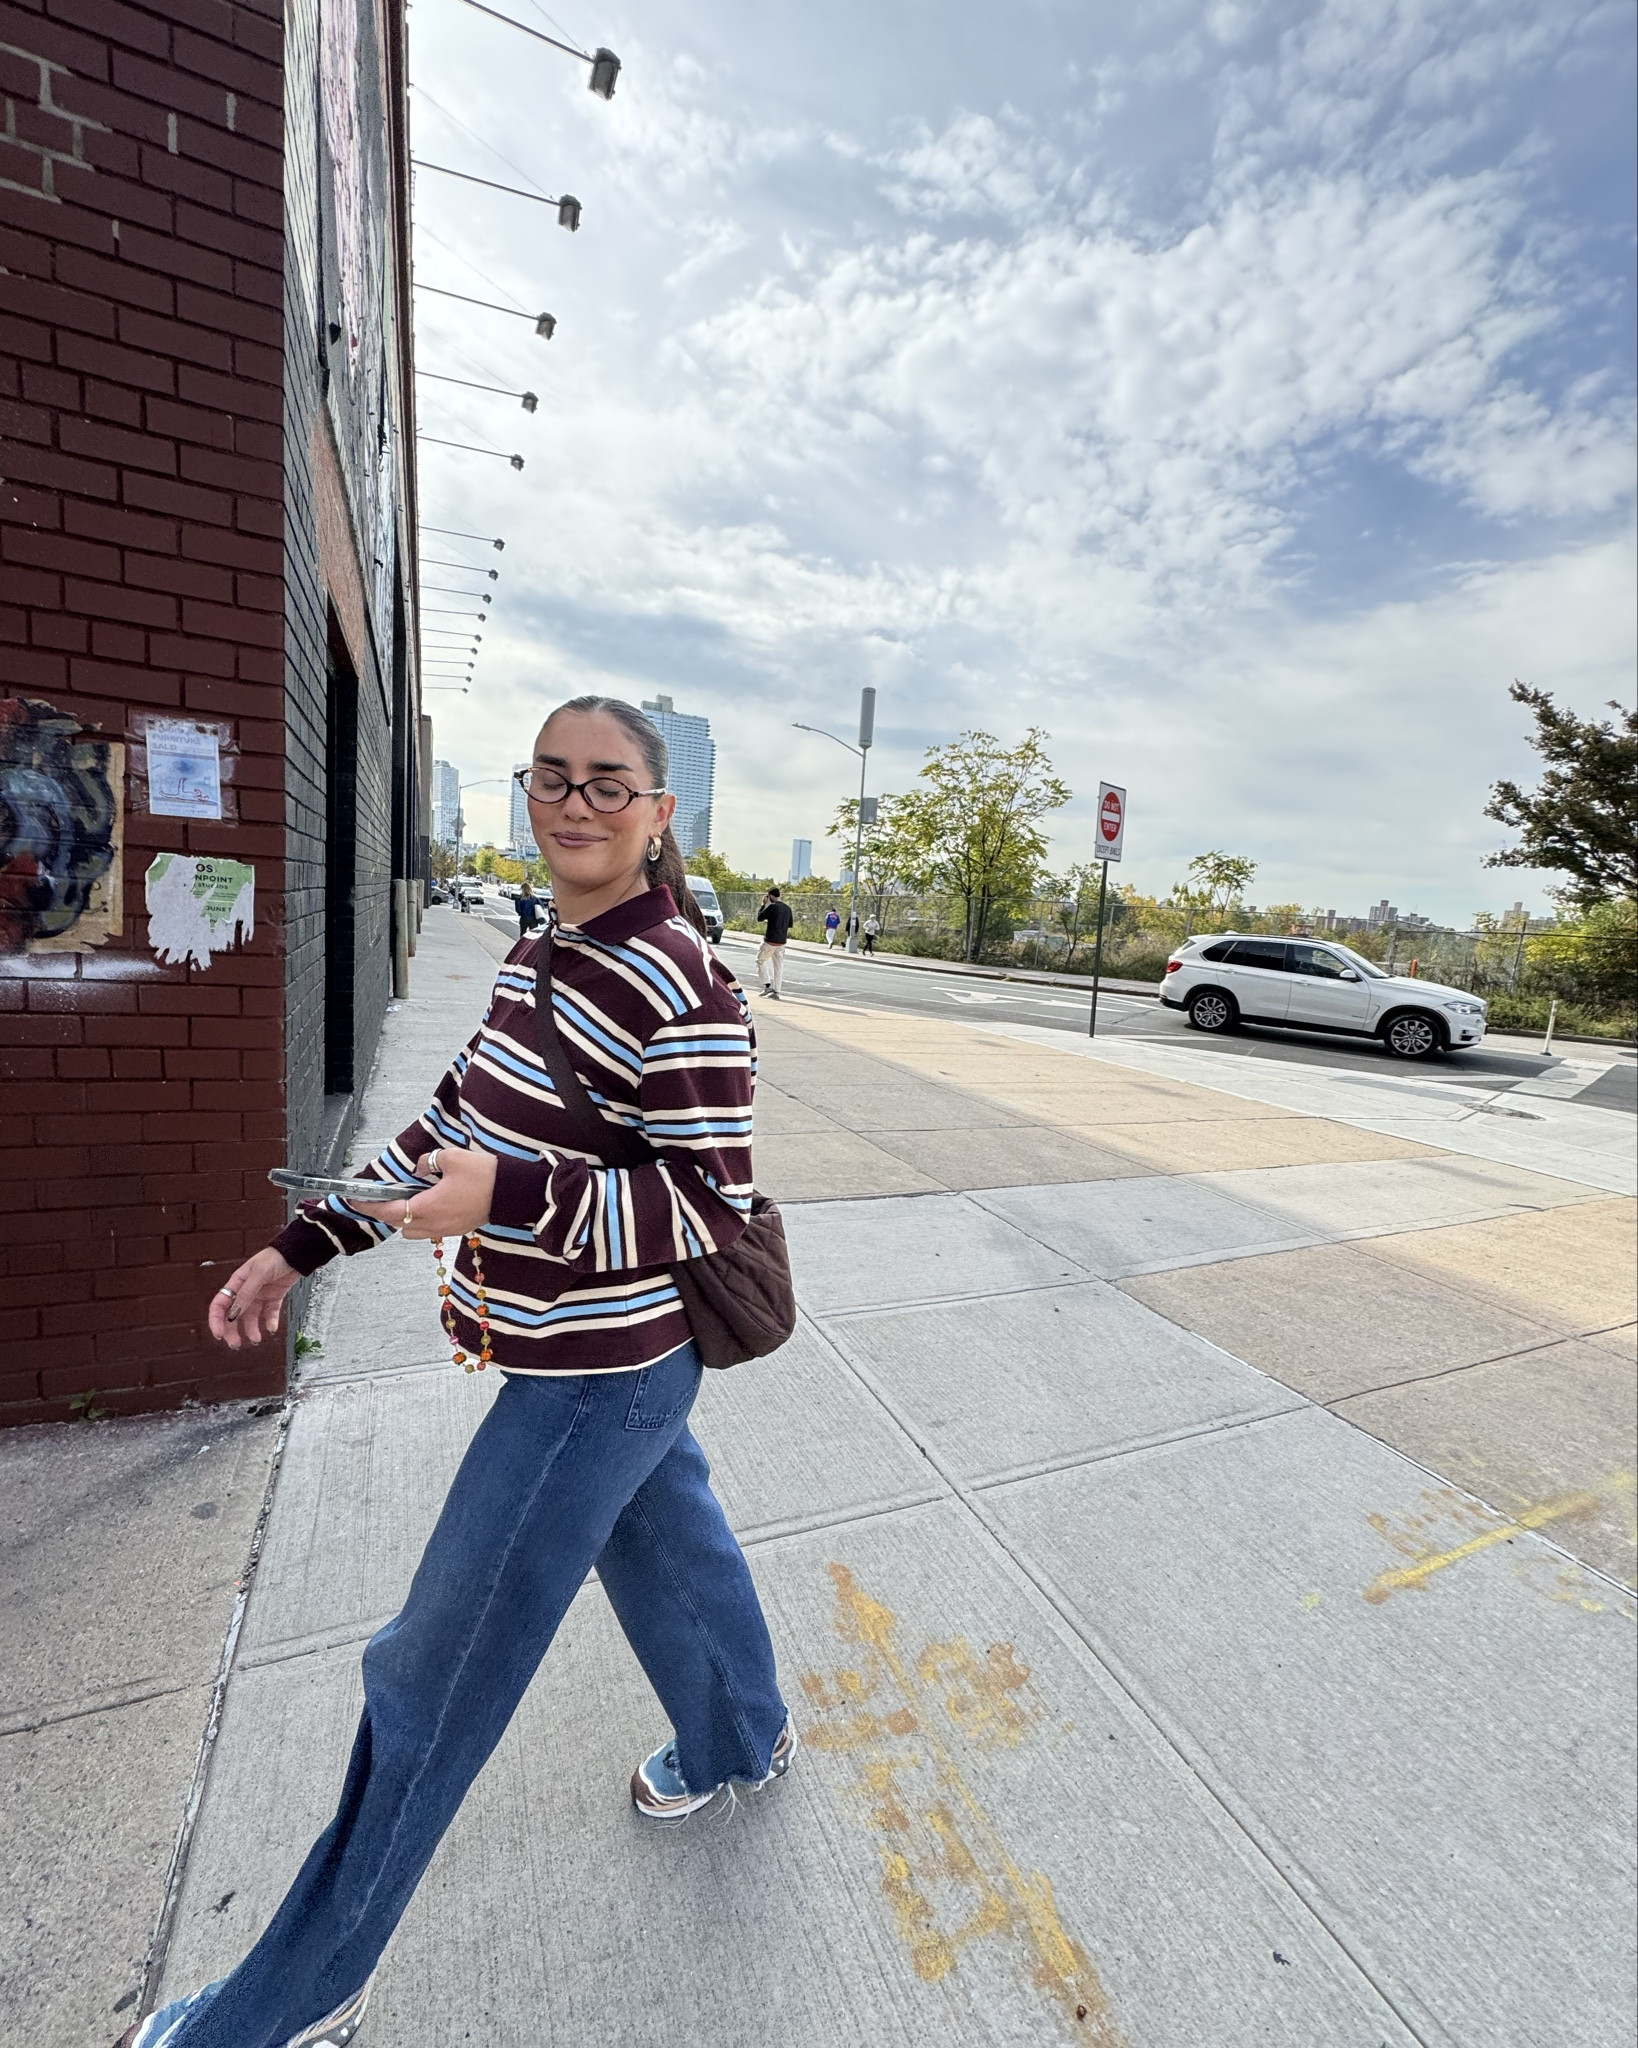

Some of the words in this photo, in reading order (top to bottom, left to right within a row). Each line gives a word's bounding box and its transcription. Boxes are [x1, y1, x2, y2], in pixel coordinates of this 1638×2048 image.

[1104, 801, 1110, 810] DO
[1111, 802, 1119, 812] NOT
[1104, 822, 1116, 832] ENTER
[195, 863, 214, 873] OS
[195, 874, 233, 883] NPOINT
